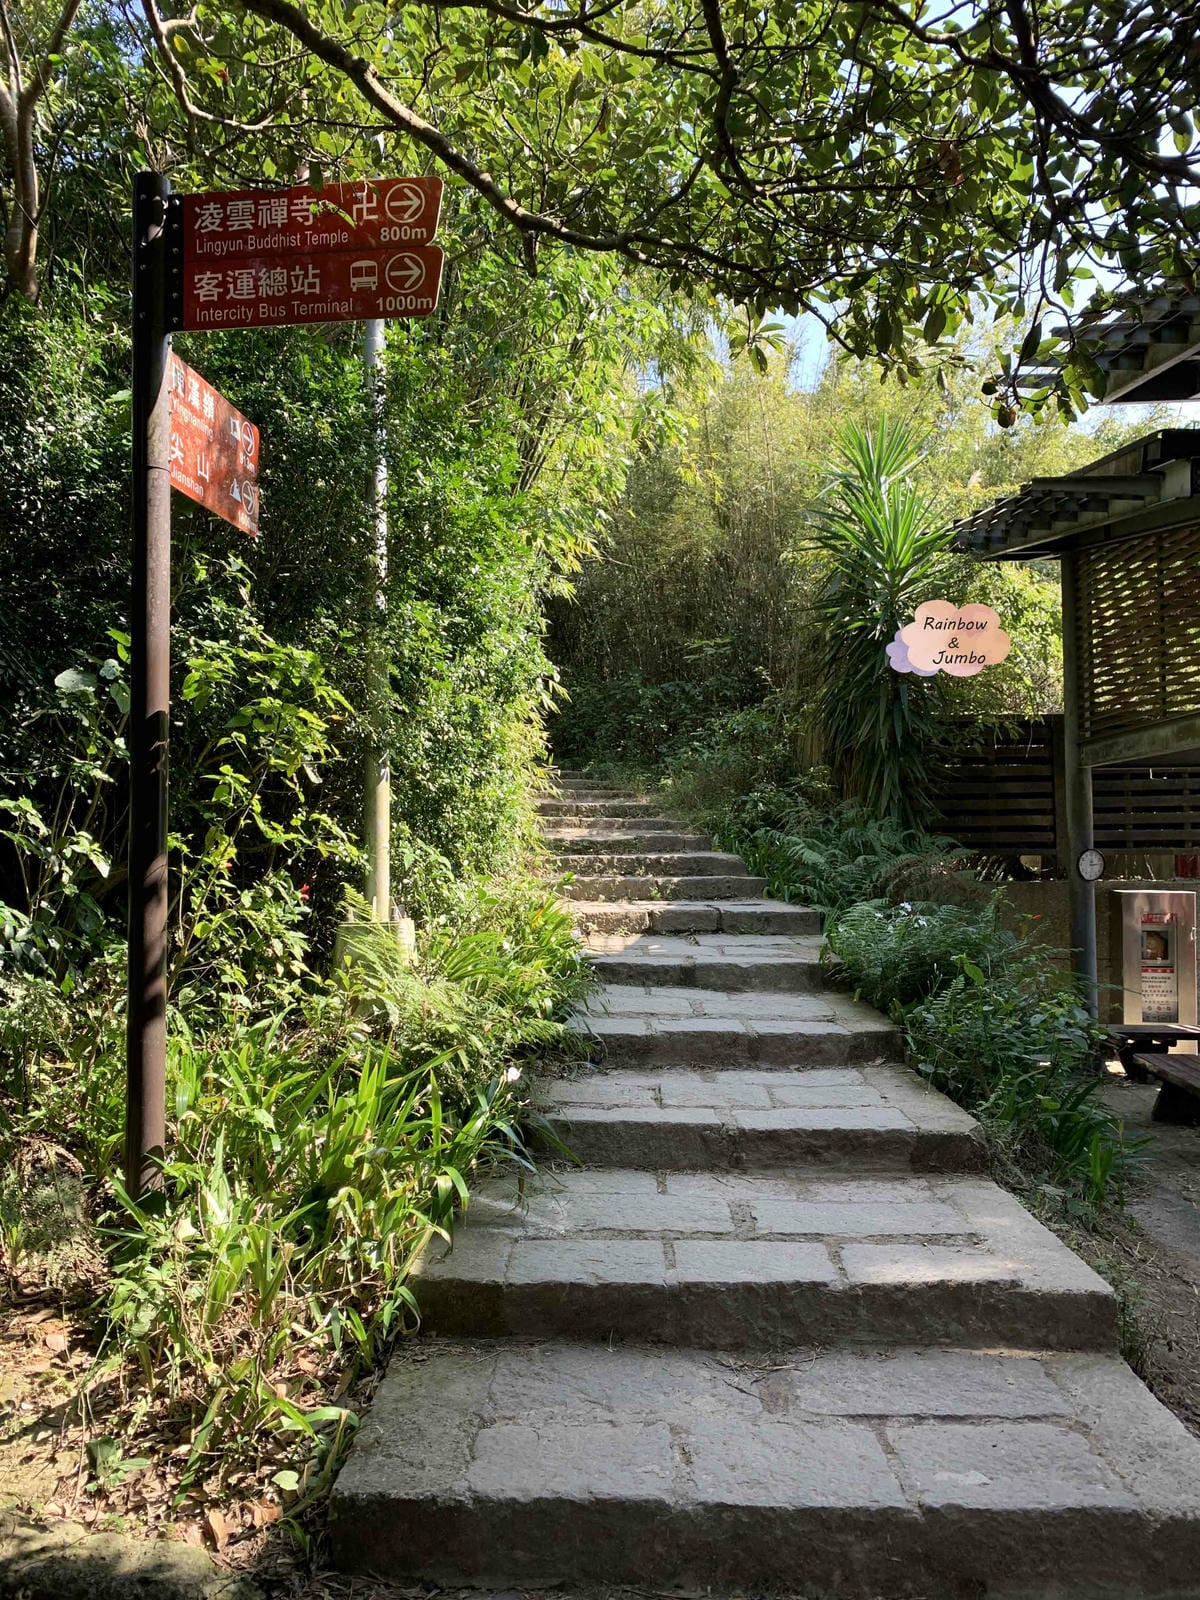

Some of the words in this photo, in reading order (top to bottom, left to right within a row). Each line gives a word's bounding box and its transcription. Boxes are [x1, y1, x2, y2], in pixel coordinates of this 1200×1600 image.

[193, 194, 318, 234] 凌雲禪寺
[195, 237, 244, 256] Lingyun
[248, 231, 301, 251] Buddhist
[305, 227, 349, 247] Temple
[380, 225, 427, 242] 800m
[193, 263, 321, 302] 客運總站
[196, 303, 253, 323] Intercity
[259, 302, 286, 318] Bus
[291, 299, 353, 318] Terminal
[376, 295, 433, 312] 1000m
[170, 463, 204, 498] Jianshan
